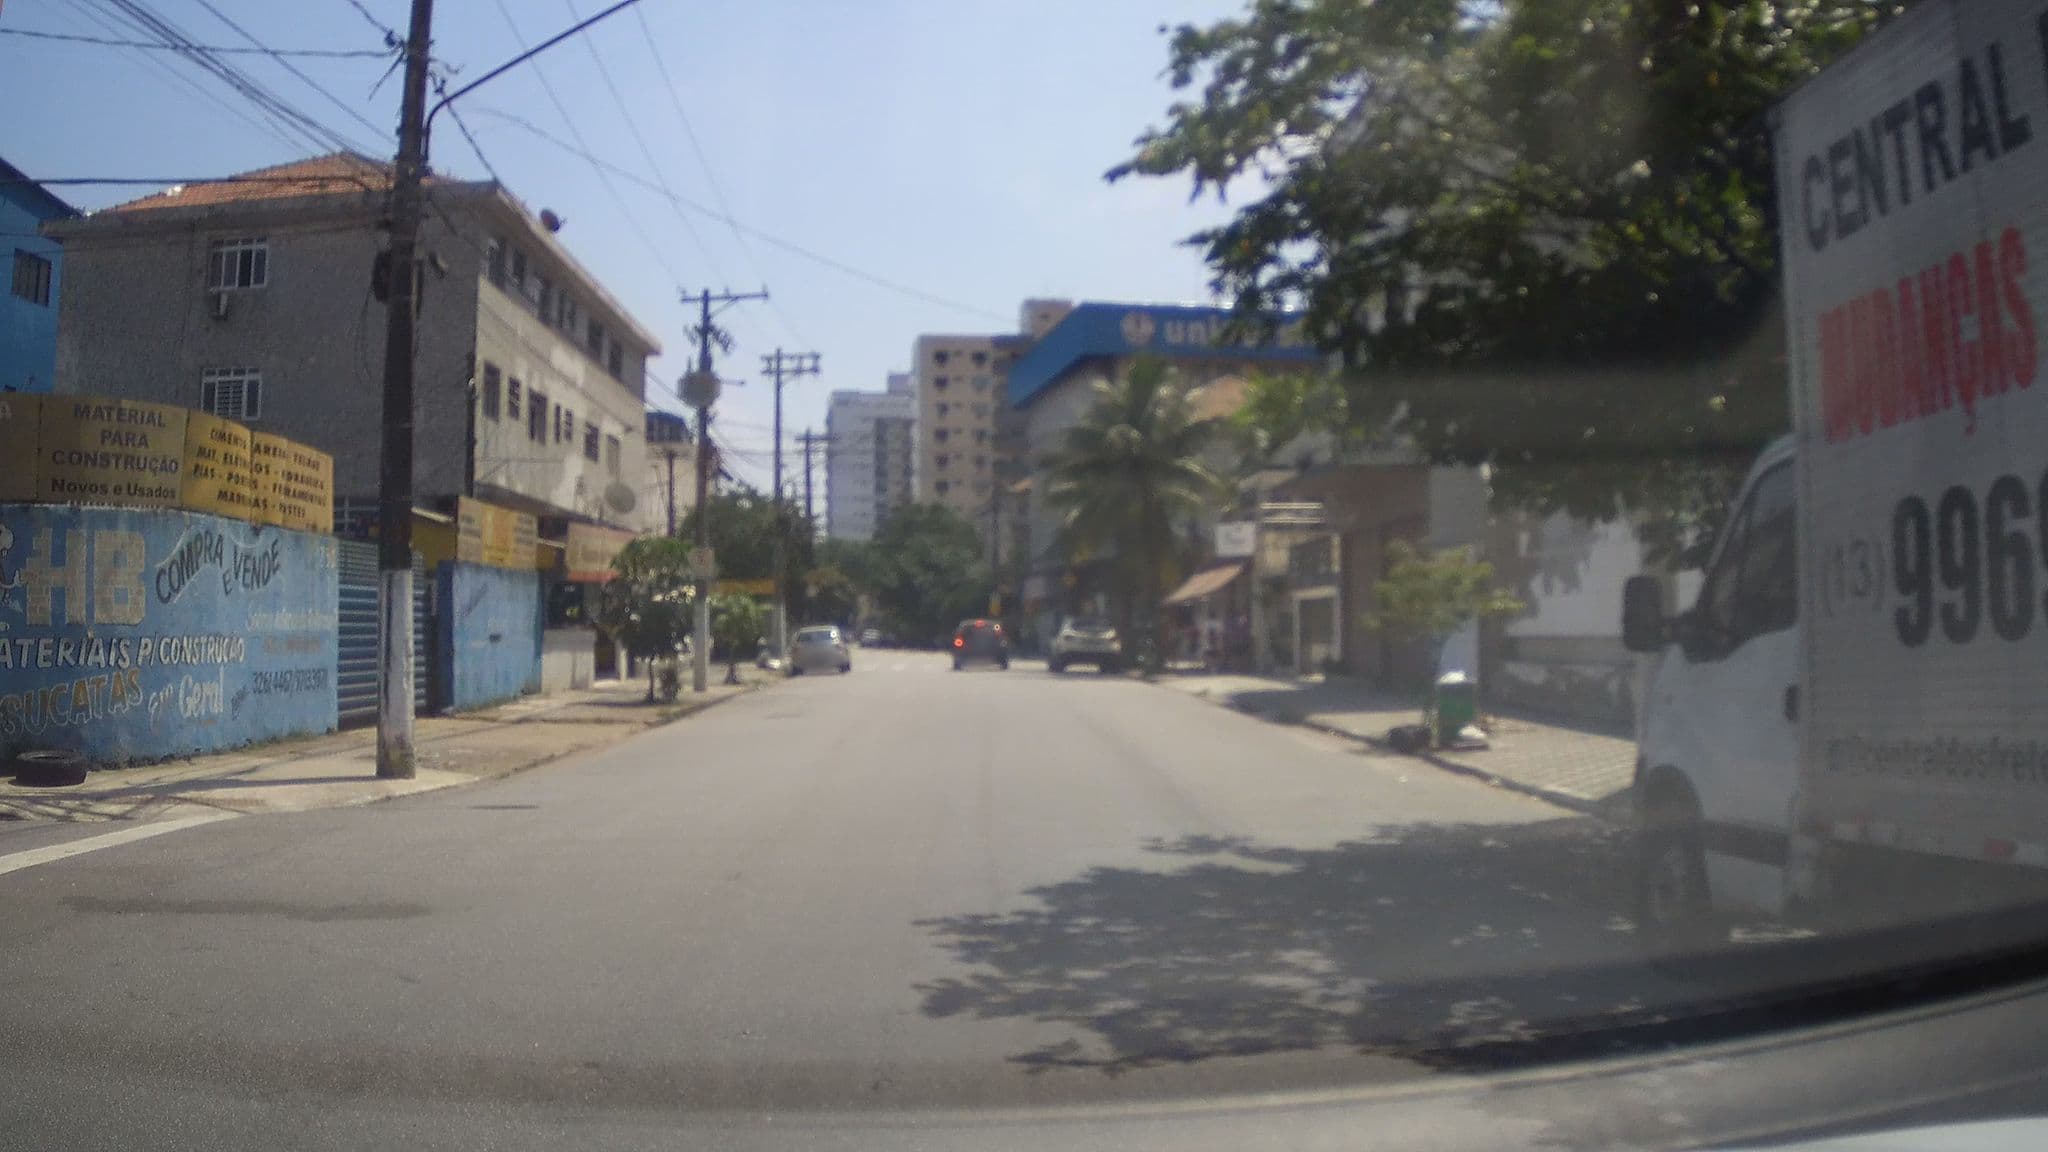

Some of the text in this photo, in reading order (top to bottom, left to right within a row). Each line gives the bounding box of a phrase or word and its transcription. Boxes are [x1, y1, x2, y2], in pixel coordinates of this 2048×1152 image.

[1799, 40, 2034, 252] CENTRAL
[1818, 225, 2038, 445] MUDANÇAS
[74, 403, 167, 428] MATERIAL
[100, 429, 150, 449] PARA
[51, 478, 177, 500] Novos e Usados
[52, 449, 179, 476] CONSTRUÇÃO
[26, 527, 146, 625] HB
[155, 530, 224, 605] COMPRA
[222, 570, 234, 599] E
[232, 537, 281, 592] VENDE
[1892, 468, 2048, 648] 996
[0, 635, 134, 671] ATERIAIS
[0, 668, 144, 735] SUCATAS
[178, 664, 225, 720] Geral
